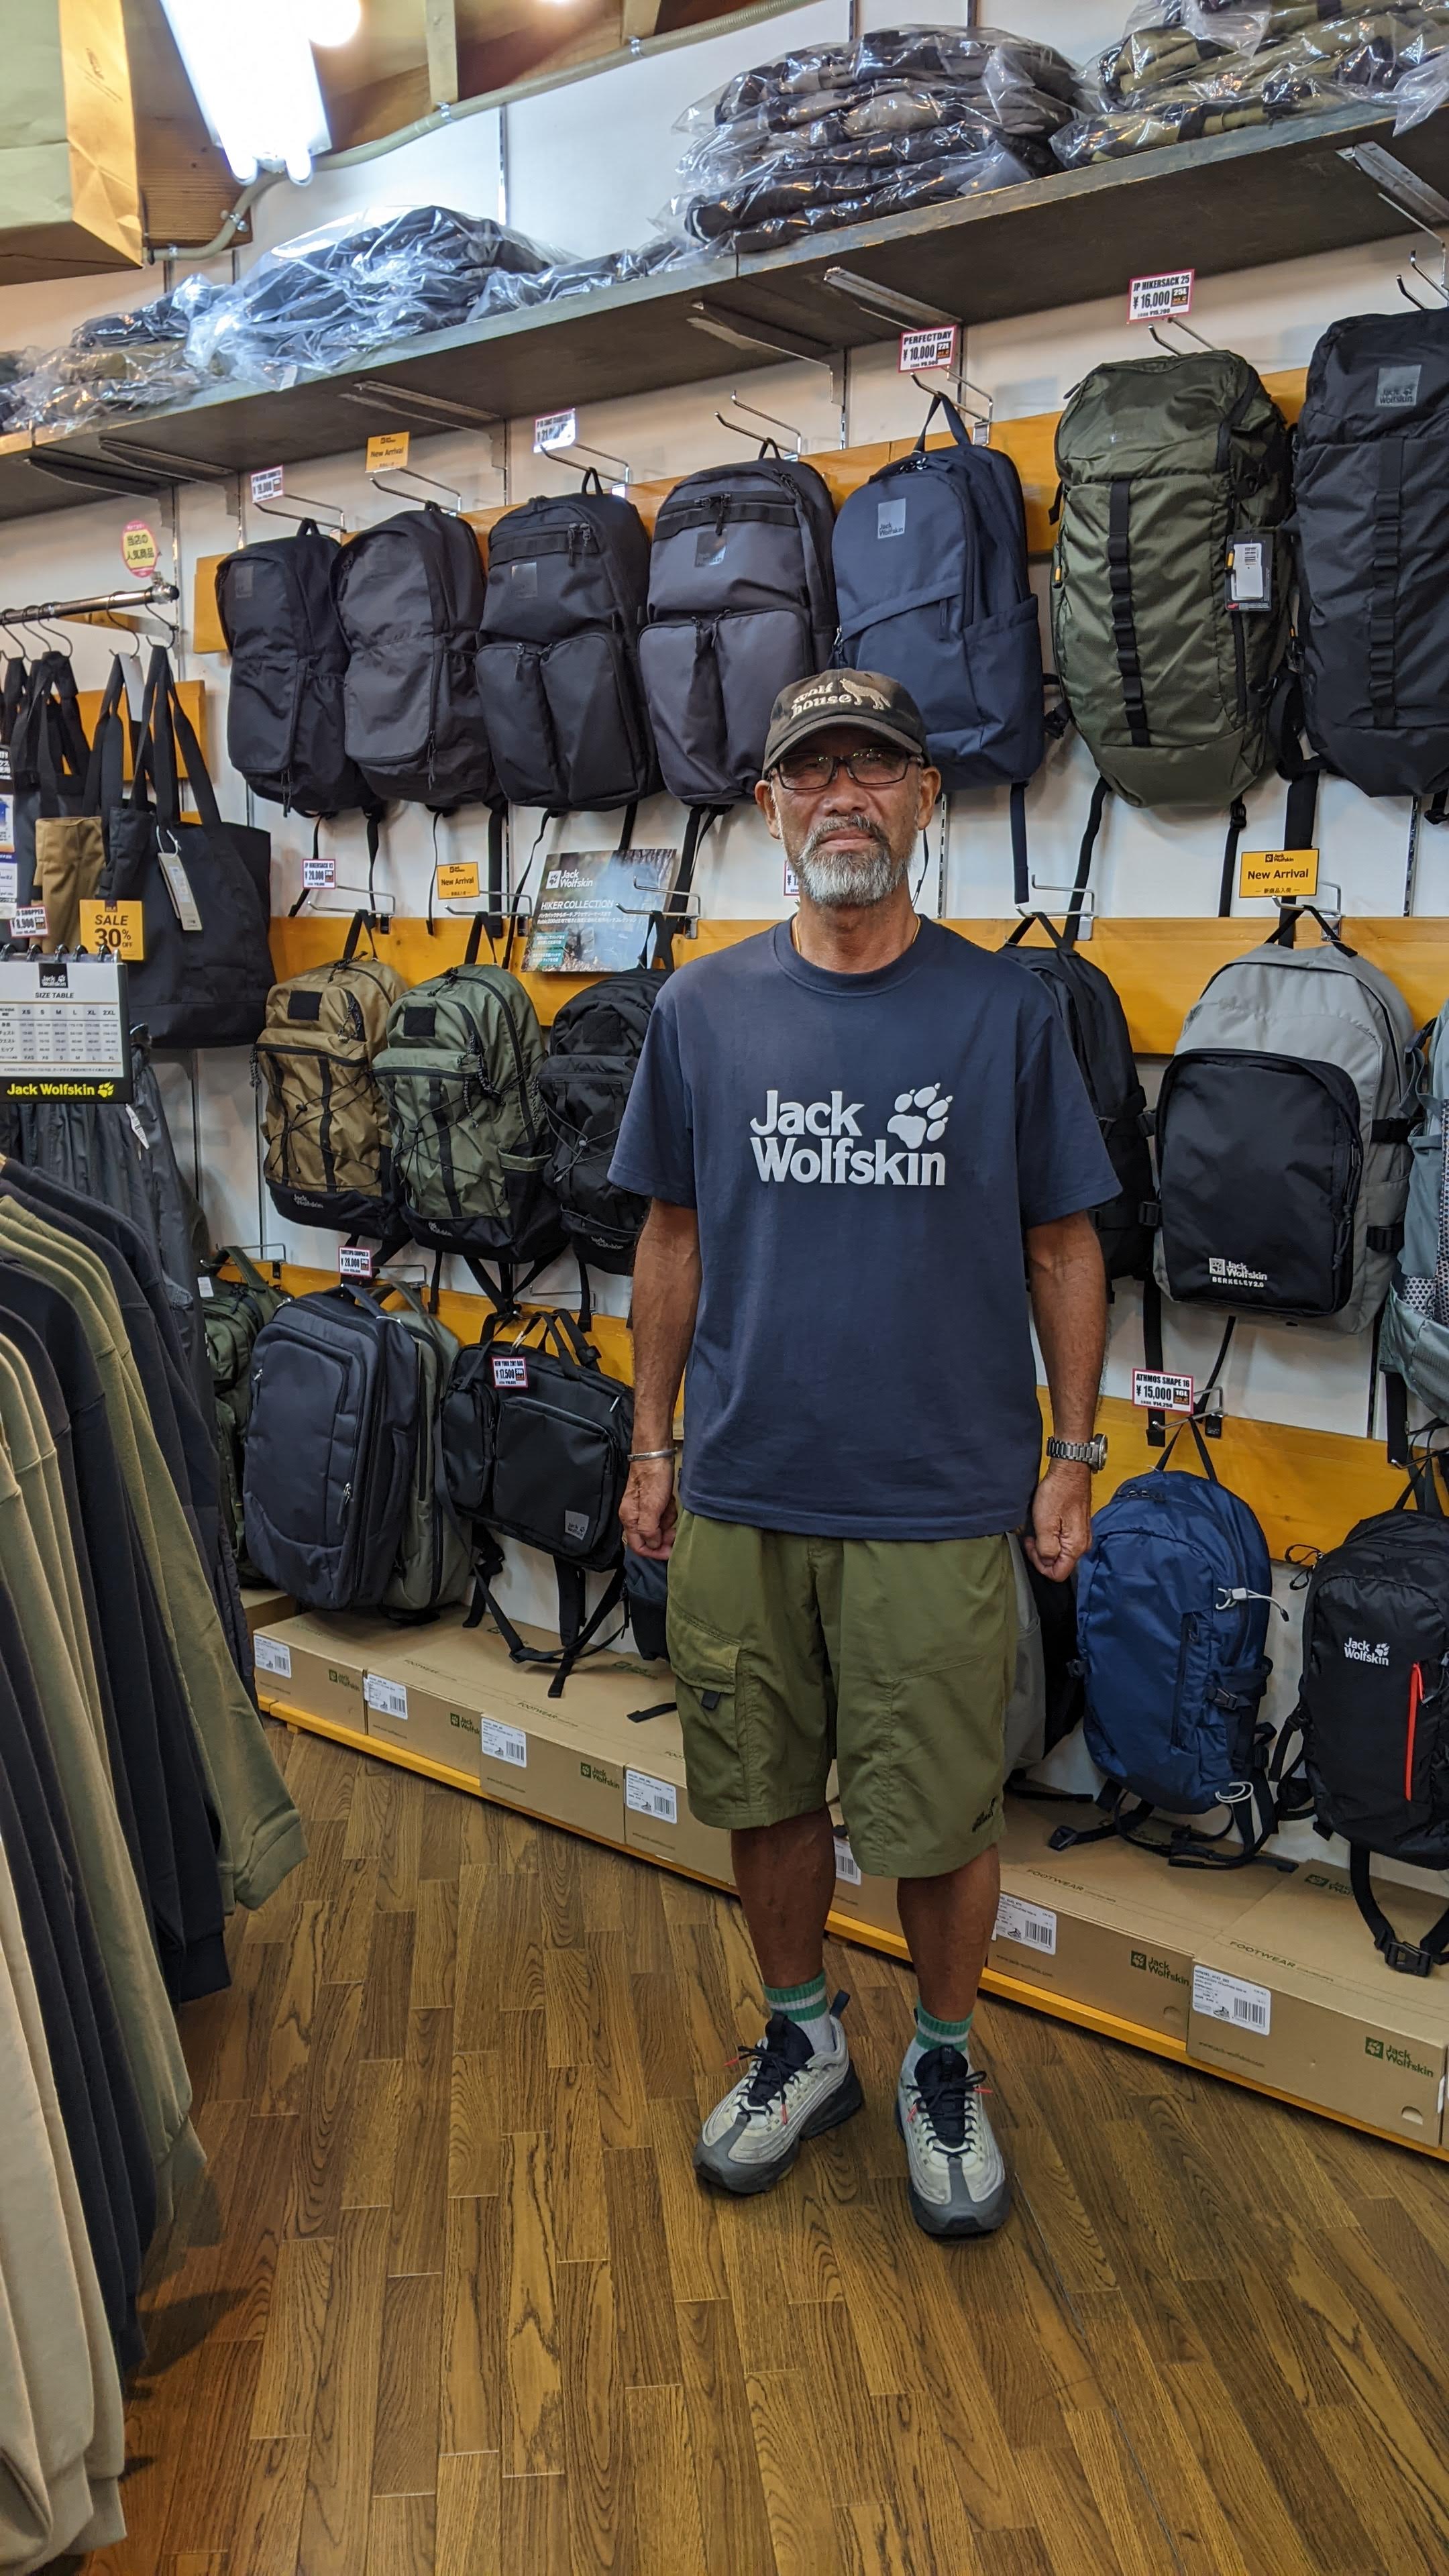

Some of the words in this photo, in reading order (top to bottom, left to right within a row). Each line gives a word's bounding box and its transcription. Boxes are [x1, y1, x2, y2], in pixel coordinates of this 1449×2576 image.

[1134, 283, 1140, 292] JP
[1142, 276, 1179, 290] HIKERSACK
[1181, 274, 1189, 284] 25
[1141, 290, 1169, 309] 16,000
[904, 331, 952, 345] PERFECTDAY
[910, 344, 935, 361] 10,000
[793, 682, 834, 704] wolf
[791, 694, 852, 720] house
[455, 876, 474, 885] Arrival
[561, 870, 580, 879] Jack
[1248, 871, 1271, 879] New
[1273, 869, 1309, 879] Arrival
[559, 878, 594, 888] Wolfskin
[541, 901, 563, 910] HIKER
[563, 900, 614, 910] COLLECTION
[95, 914, 129, 925] SALE
[7, 1083, 38, 1095] Jack
[40, 1083, 95, 1095] Wolfskin
[749, 1090, 865, 1137] Jack
[749, 1136, 947, 1186] Wolfskin
[1226, 1261, 1246, 1270] Jack
[1226, 1268, 1268, 1281] Wolfskin
[499, 1368, 515, 1379] 17,500
[1136, 1374, 1161, 1383] ATHMOS
[1162, 1377, 1181, 1387] SHAPE
[1183, 1379, 1190, 1387] 16
[1136, 1385, 1141, 1396] ¥
[1144, 1385, 1172, 1401] 15,000
[1344, 1637, 1370, 1652] Jack
[1344, 1647, 1389, 1666] Wolfskin
[517, 1702, 557, 1719] FOOTWEAR
[461, 1717, 473, 1725] Jack
[592, 1767, 606, 1777] Jack
[592, 1774, 620, 1790] Wolfskin
[1026, 1869, 1084, 1891] FOOTWEAR
[1229, 1941, 1296, 1968] FOOTWEAR
[1148, 1956, 1169, 1970] Jack
[1148, 1964, 1189, 1986] Wolfskin
[1386, 2045, 1411, 2058] Jack
[1386, 2052, 1434, 2078] Wolfskin
